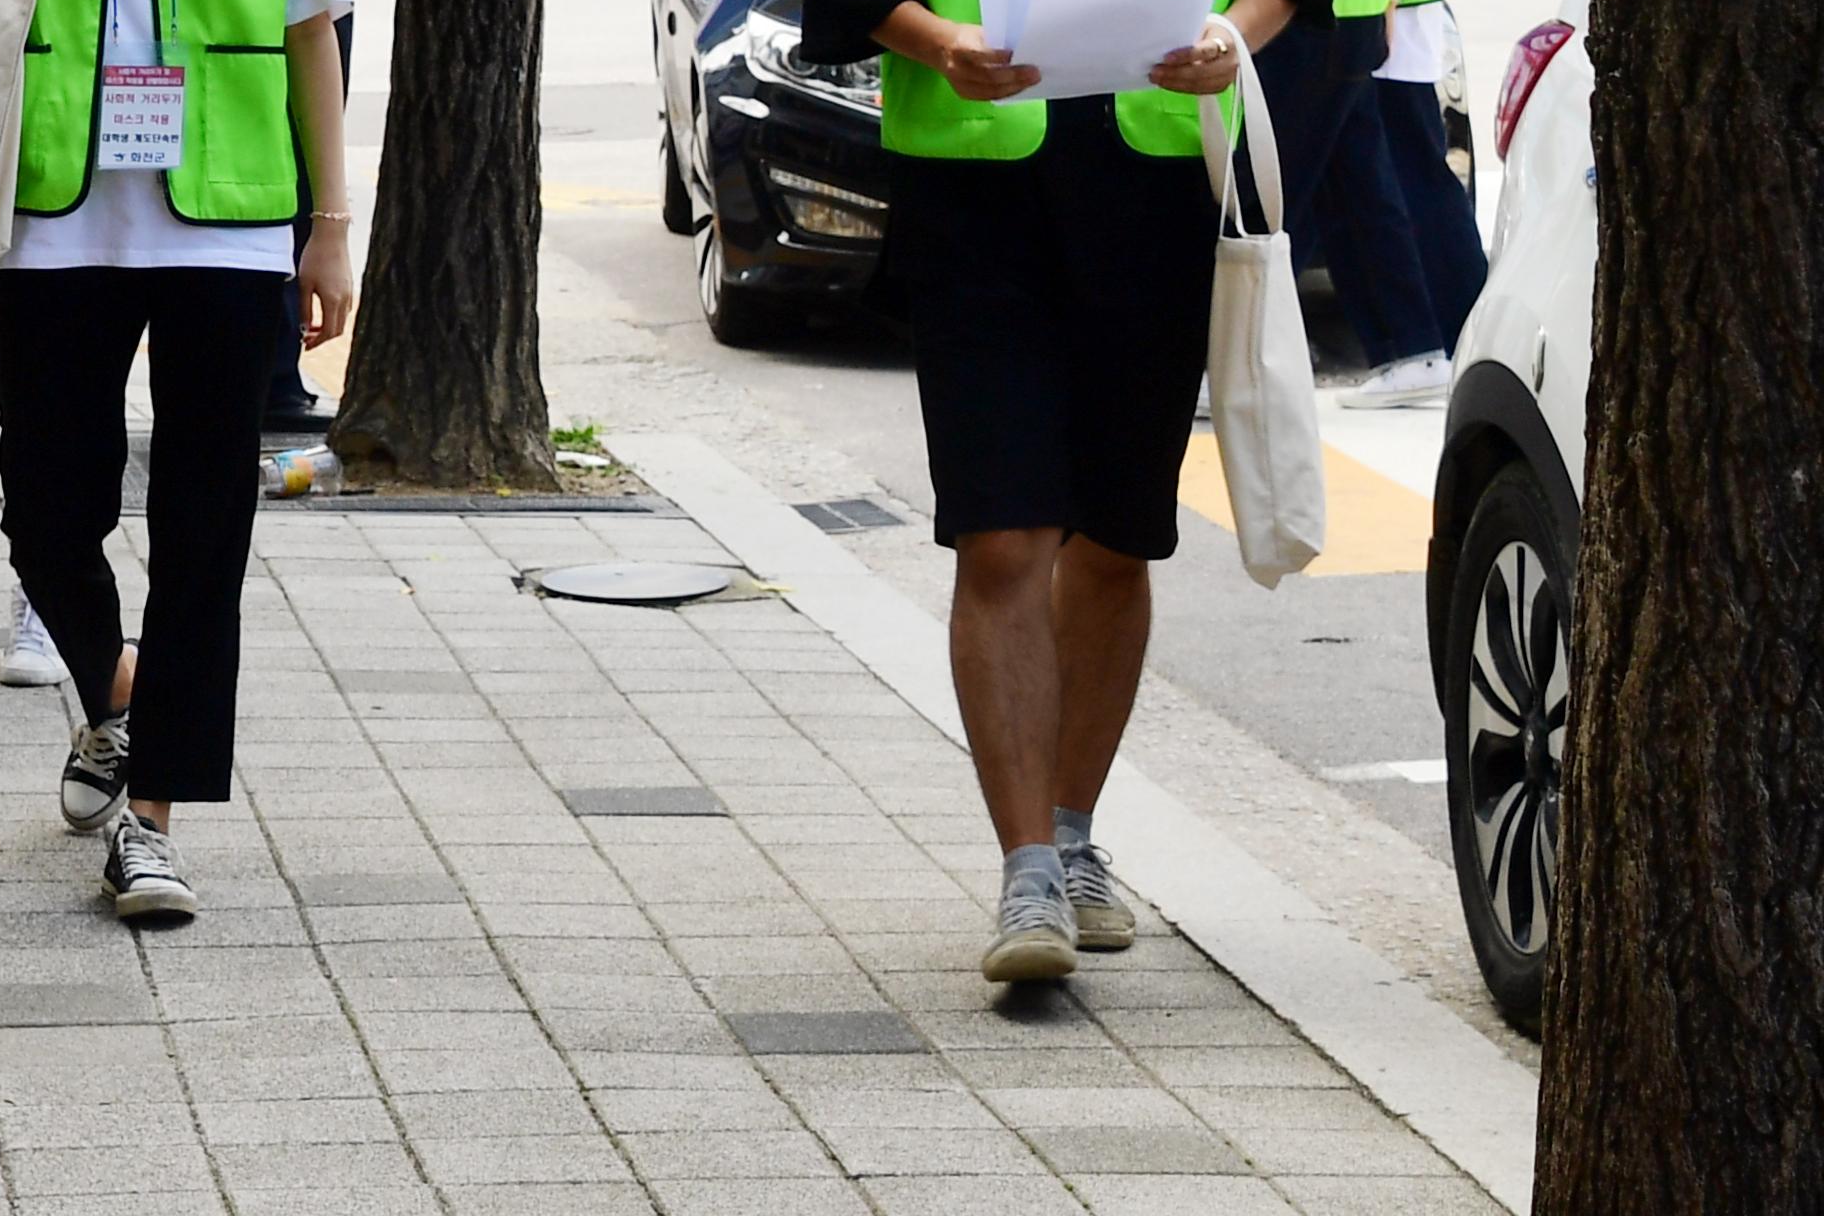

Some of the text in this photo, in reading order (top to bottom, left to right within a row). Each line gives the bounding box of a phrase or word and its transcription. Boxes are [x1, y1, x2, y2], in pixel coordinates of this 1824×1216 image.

[141, 93, 181, 105] 거리두기
[114, 114, 144, 124] 마스크
[102, 133, 129, 143] 대학생
[131, 152, 165, 163] 화천군
